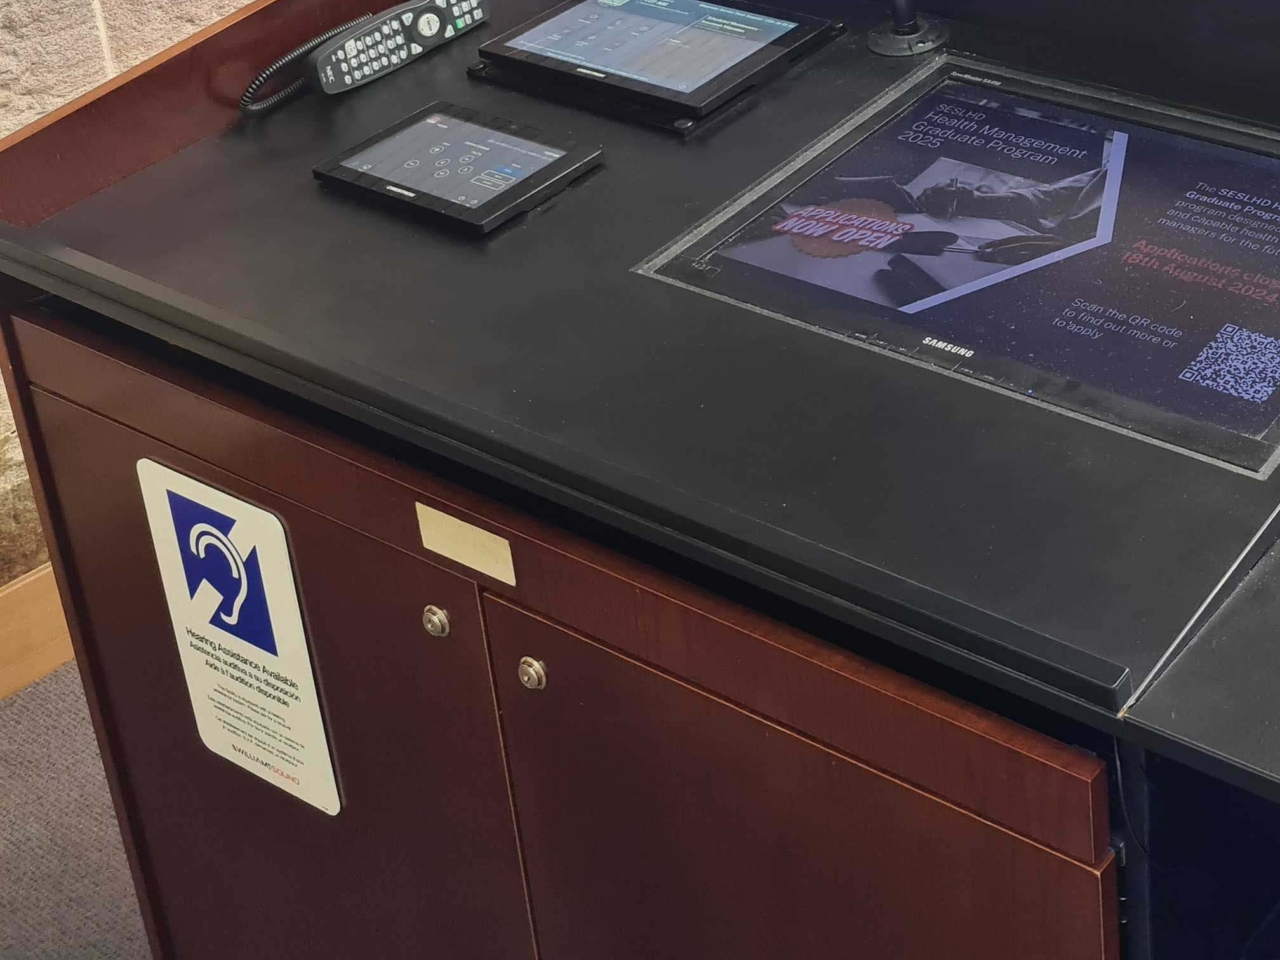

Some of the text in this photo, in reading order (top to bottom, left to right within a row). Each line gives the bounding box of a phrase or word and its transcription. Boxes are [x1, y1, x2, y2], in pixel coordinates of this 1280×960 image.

[326, 66, 335, 83] NEC
[936, 104, 985, 121] SESLHD
[898, 131, 944, 149] 2025
[912, 121, 1058, 165] Graduate Program
[924, 111, 1088, 159] Health Management
[1185, 191, 1241, 211] Graduate
[1196, 182, 1217, 193] The
[1217, 188, 1272, 207] SESLHD
[794, 207, 911, 234] APPLICATIONS
[1175, 200, 1225, 219] program
[776, 218, 900, 248] NOW OPEN
[1158, 218, 1216, 240] managers
[1219, 232, 1237, 244] for
[1239, 237, 1259, 250] the
[1167, 207, 1190, 219] and
[1191, 214, 1238, 234] capable
[1240, 227, 1278, 243] health
[1132, 239, 1240, 276] Applications
[1122, 252, 1278, 304] 18th August 2024
[1052, 317, 1104, 340] to apply
[1062, 308, 1178, 349] to find out more or
[1072, 298, 1183, 338] Scan the QR code
[923, 337, 975, 357] SAMSUNG
[186, 626, 299, 690] Hearing Assistance Available
[190, 641, 221, 662] Asistencia
[256, 686, 289, 707] disponible
